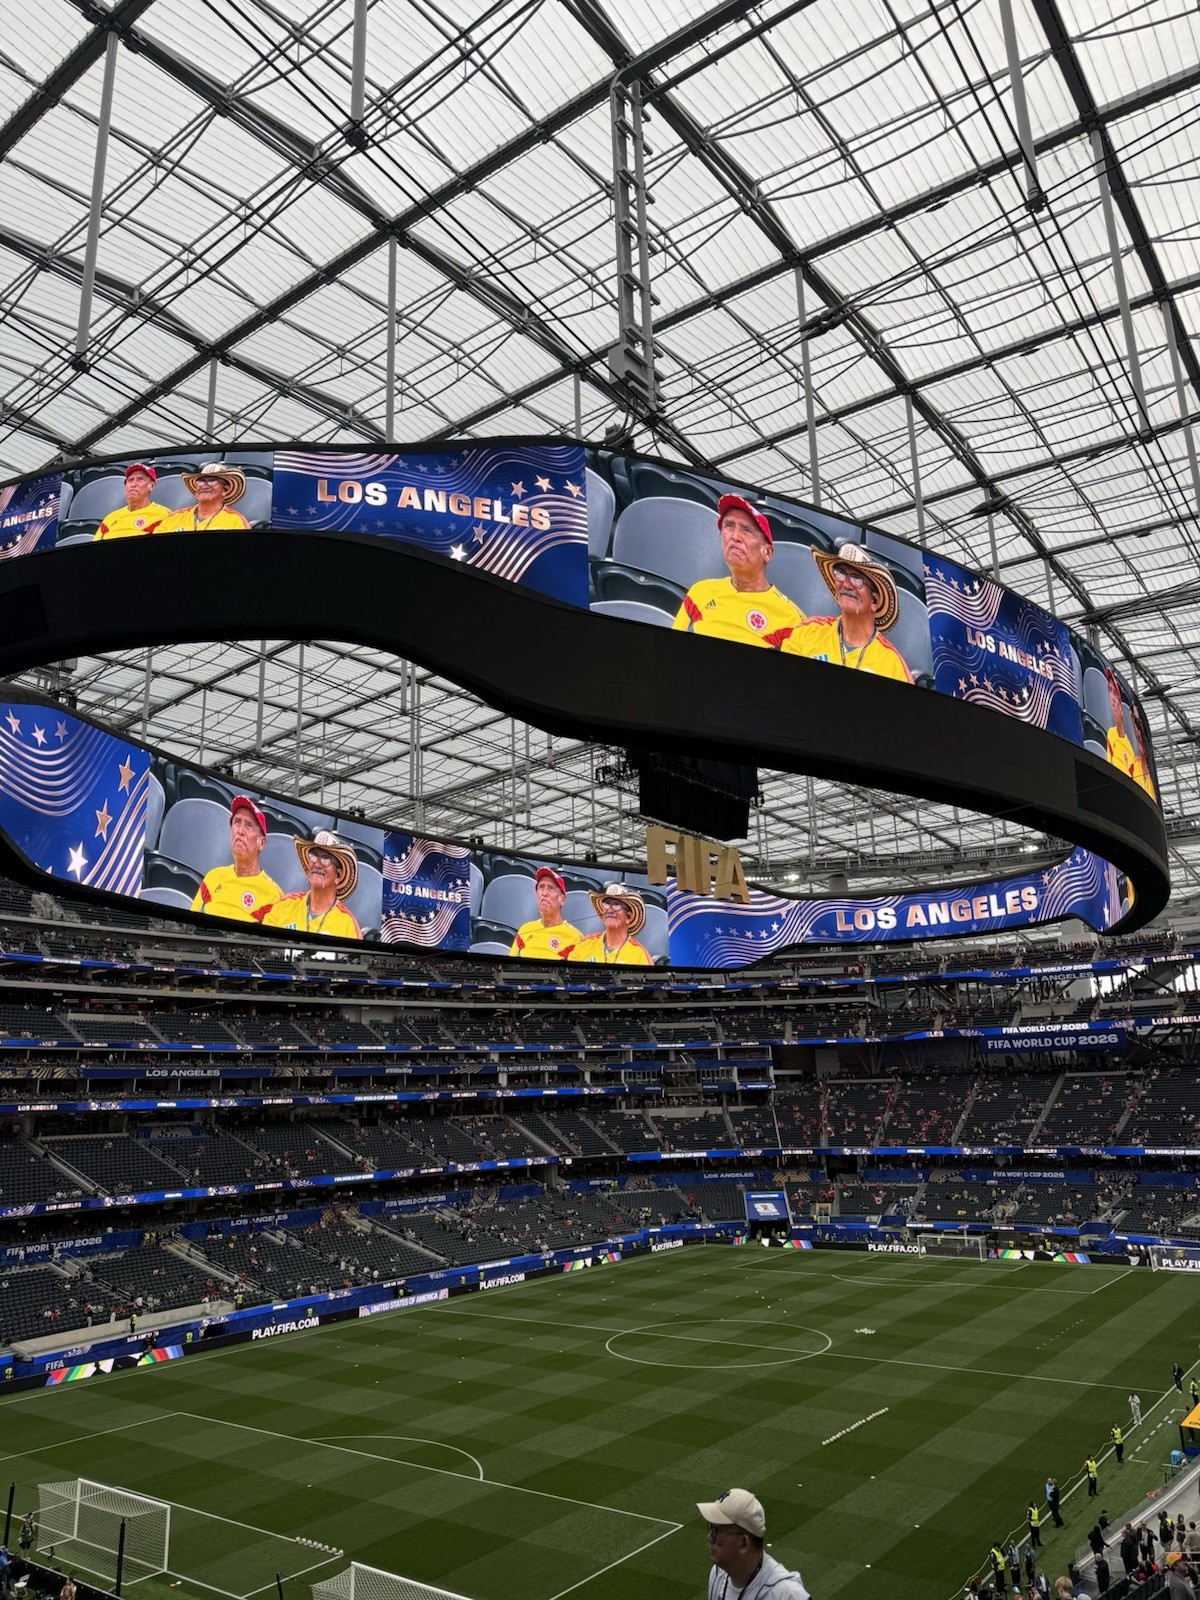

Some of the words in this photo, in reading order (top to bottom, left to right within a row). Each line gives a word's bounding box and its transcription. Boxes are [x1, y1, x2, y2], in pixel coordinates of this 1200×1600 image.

[317, 479, 388, 506] LOS
[397, 486, 551, 531] ANGELES
[3, 507, 53, 528] ANGELES
[966, 626, 996, 653] LOS
[999, 641, 1053, 681] ANGELES
[646, 824, 751, 904] FIFA
[391, 882, 412, 896] LOS
[414, 886, 462, 903] ANGELES
[835, 907, 897, 931] LOS
[906, 886, 1038, 927] ANGELES
[1167, 953, 1194, 962] ANGELES
[1041, 972, 1094, 981] ANGELES
[1020, 1025, 1046, 1033] WORLD
[1046, 1024, 1061, 1032] CUP
[1062, 1023, 1089, 1031] 2026
[1152, 1017, 1169, 1025] LOS
[987, 1040, 1011, 1049] FIFA
[1012, 1038, 1053, 1048] WORLD
[1054, 1036, 1076, 1046] CUP
[1078, 1034, 1118, 1045] 2026
[146, 1069, 168, 1077] LOS
[170, 1069, 220, 1077] ANGELES
[252, 1213, 288, 1223] ANGEES
[58, 1240, 74, 1250] CUP
[74, 1236, 103, 1247] 2026
[480, 1272, 525, 1290] PLAY.FIFA.COM
[370, 1301, 389, 1313] UNITED
[389, 1297, 409, 1309] STATES
[408, 1297, 416, 1305] OF
[416, 1291, 438, 1303] AMERICA
[252, 1316, 319, 1340] PLAY.FIFA.COM
[45, 1359, 65, 1371] FIFA
